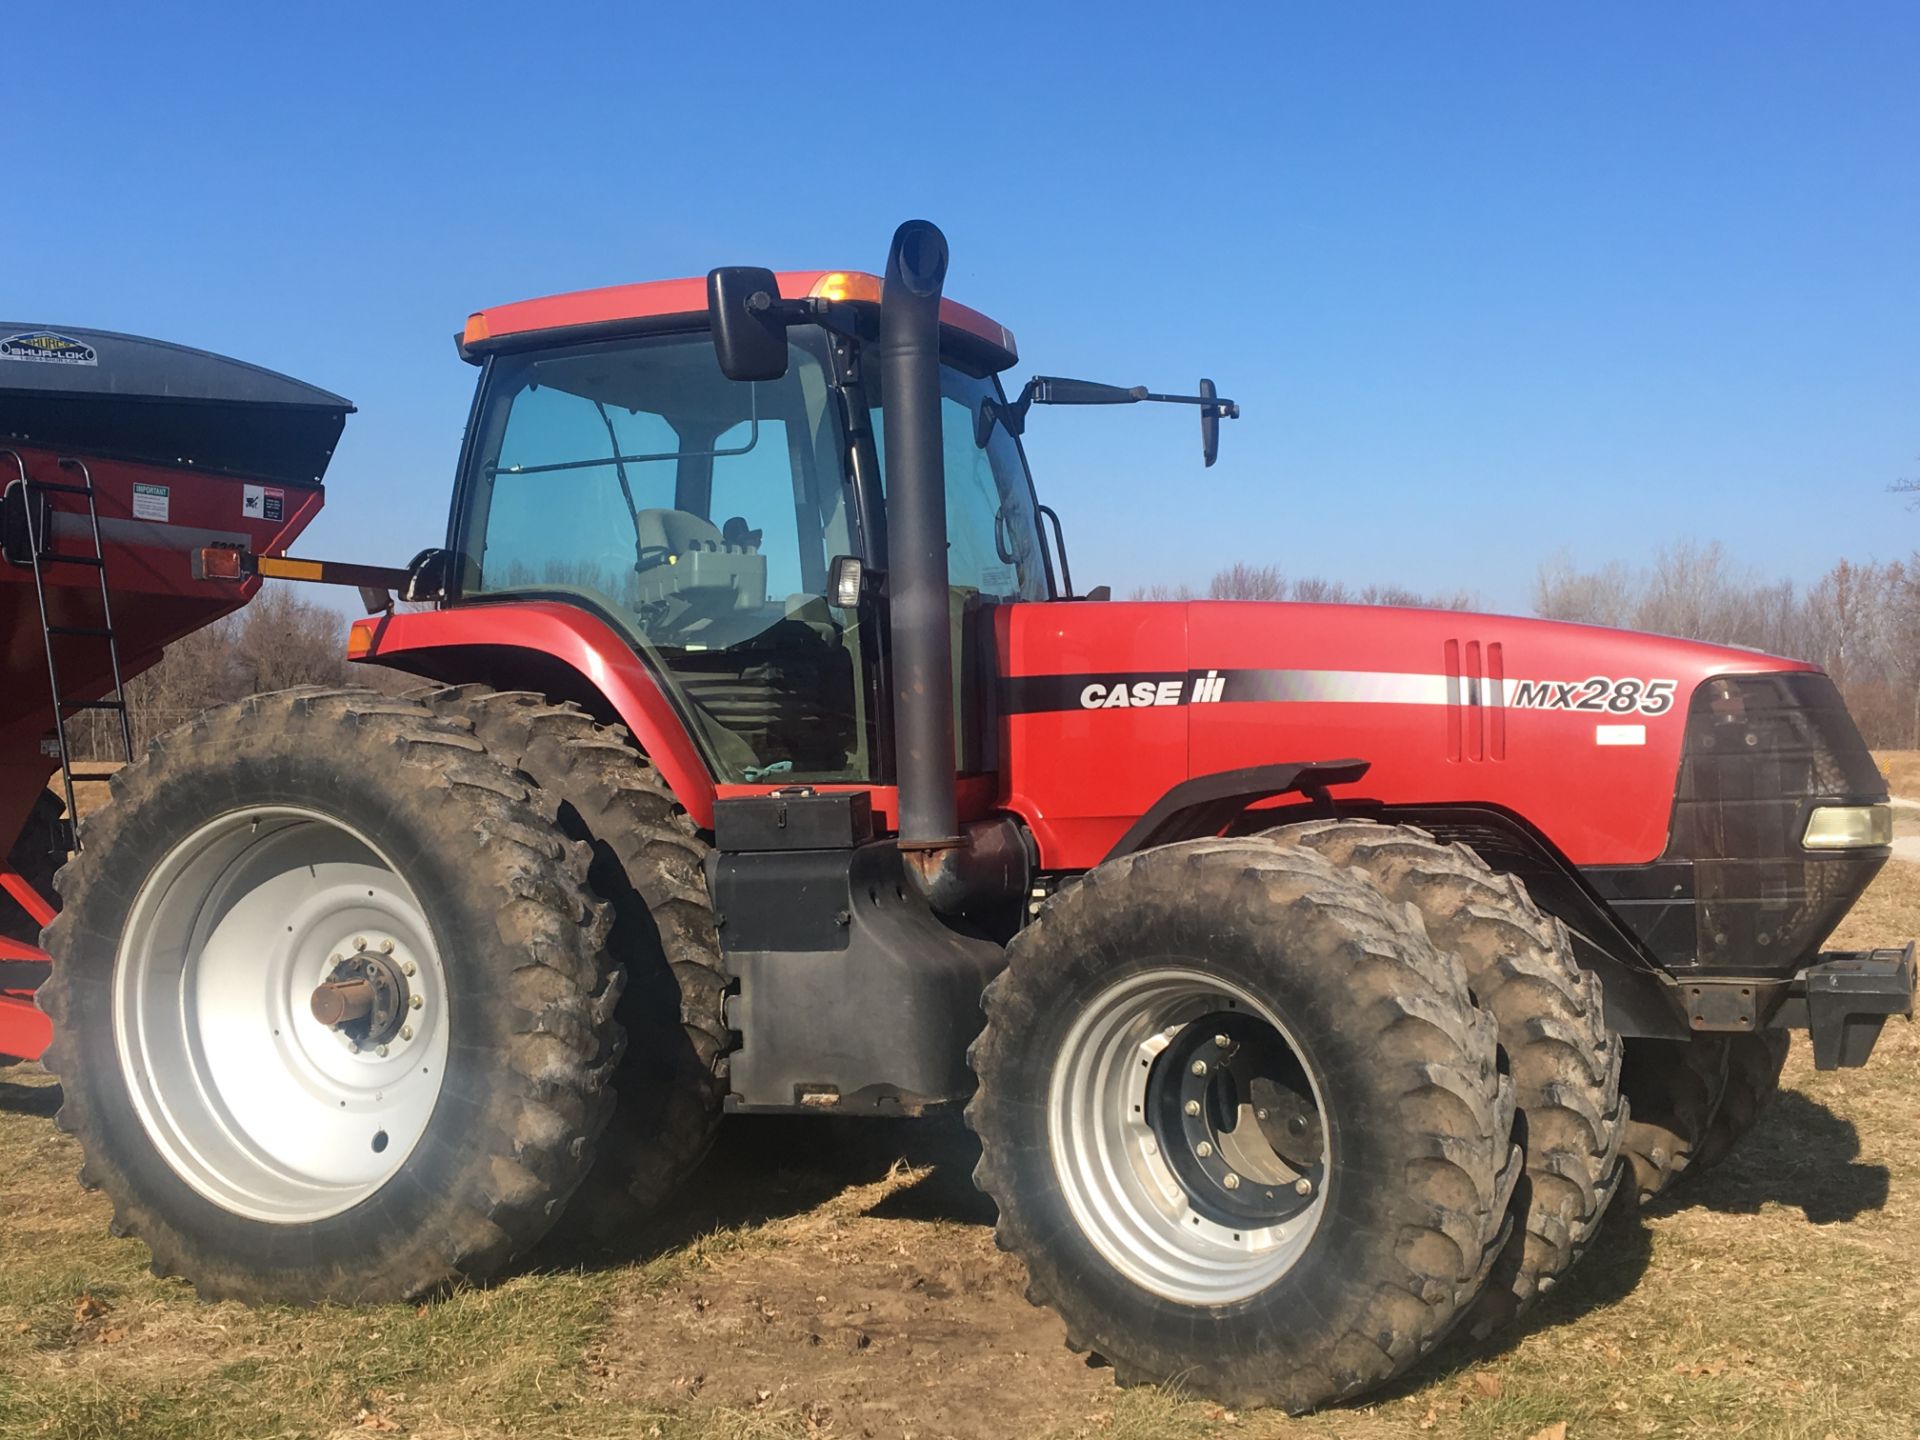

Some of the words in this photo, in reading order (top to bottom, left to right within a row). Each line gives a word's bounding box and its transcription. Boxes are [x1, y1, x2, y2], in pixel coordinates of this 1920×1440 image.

[11, 348, 84, 361] SHUR-LOK
[135, 485, 167, 497] IMPORTANT
[1080, 681, 1183, 709] CASE
[1513, 676, 1679, 717] MX285
